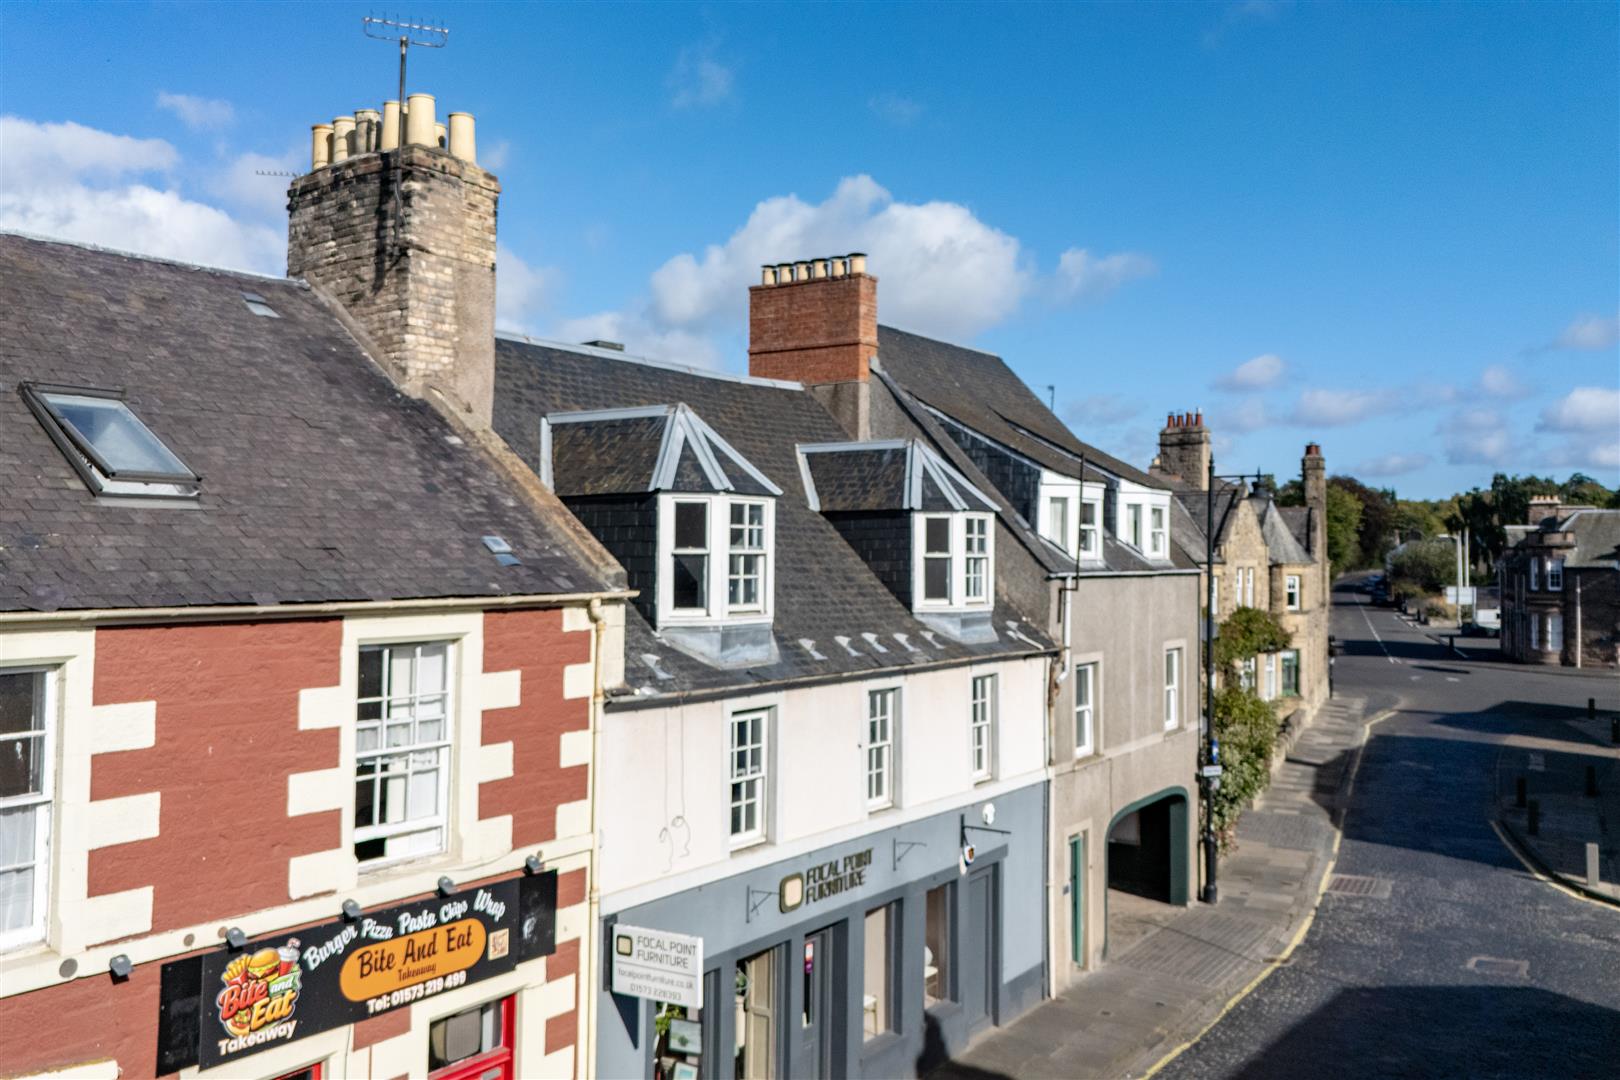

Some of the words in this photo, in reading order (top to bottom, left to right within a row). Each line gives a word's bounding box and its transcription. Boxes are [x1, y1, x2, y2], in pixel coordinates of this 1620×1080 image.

[806, 860, 841, 886] FOCAL
[843, 847, 873, 872] POINT
[806, 870, 866, 905] FURNITURE
[303, 925, 358, 971] Burger
[361, 918, 393, 940] Pizza
[397, 909, 437, 935] Pasta
[440, 900, 468, 923] Chips
[473, 889, 506, 923] Wrap
[637, 936, 668, 951] FOCAL
[670, 941, 697, 956] POINT
[357, 949, 396, 979] Bite
[402, 932, 438, 965] And
[446, 924, 473, 953] Eat
[637, 950, 688, 969] FURNITURE
[270, 977, 293, 994] and
[397, 963, 437, 982] Takeaway
[219, 979, 268, 1020] Bite
[250, 989, 298, 1031] Eat
[366, 993, 390, 1014] Tel:
[391, 982, 424, 1007] 01573
[424, 977, 444, 996] 219
[444, 970, 467, 989] 499
[218, 1020, 298, 1056] Takeaway
